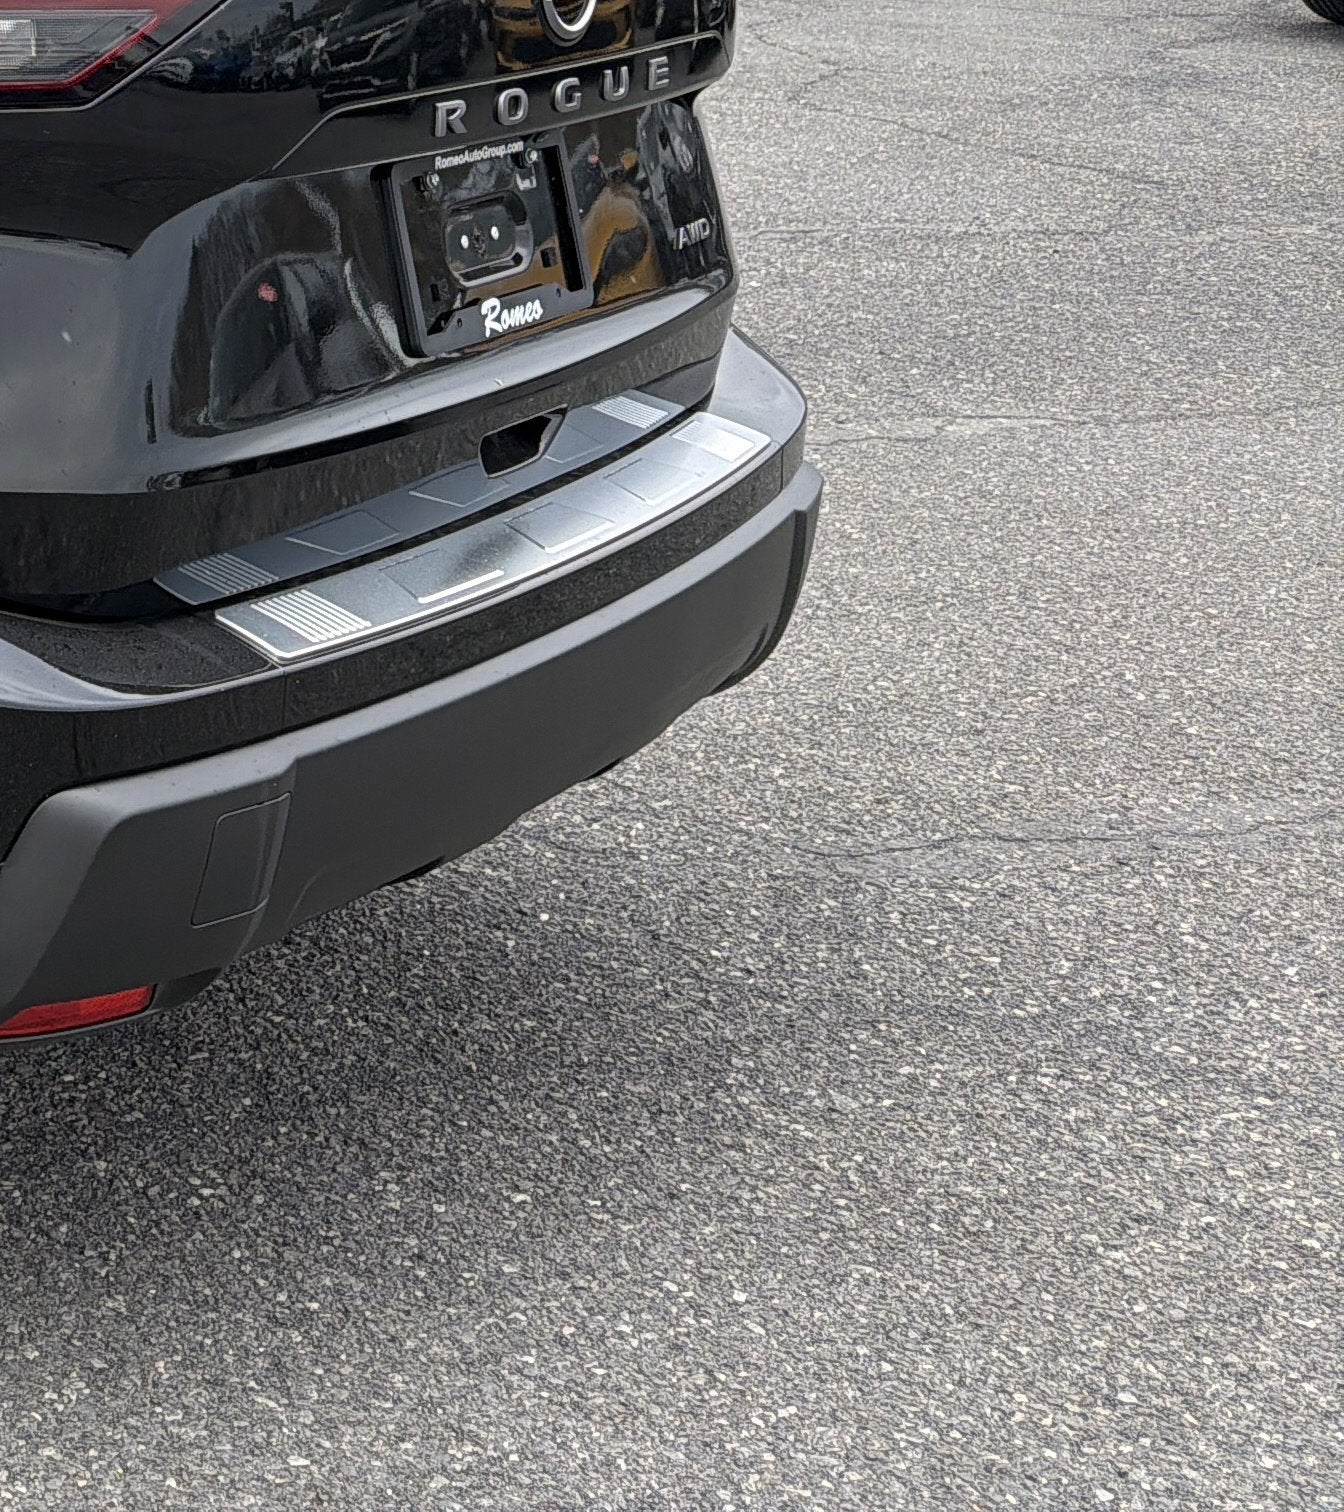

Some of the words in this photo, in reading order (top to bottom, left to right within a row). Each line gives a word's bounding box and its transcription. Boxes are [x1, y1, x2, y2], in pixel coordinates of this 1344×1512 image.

[433, 56, 670, 138] ROGUE
[435, 140, 524, 170] RomeoAutoGroup.com
[481, 296, 544, 337] Romeo
